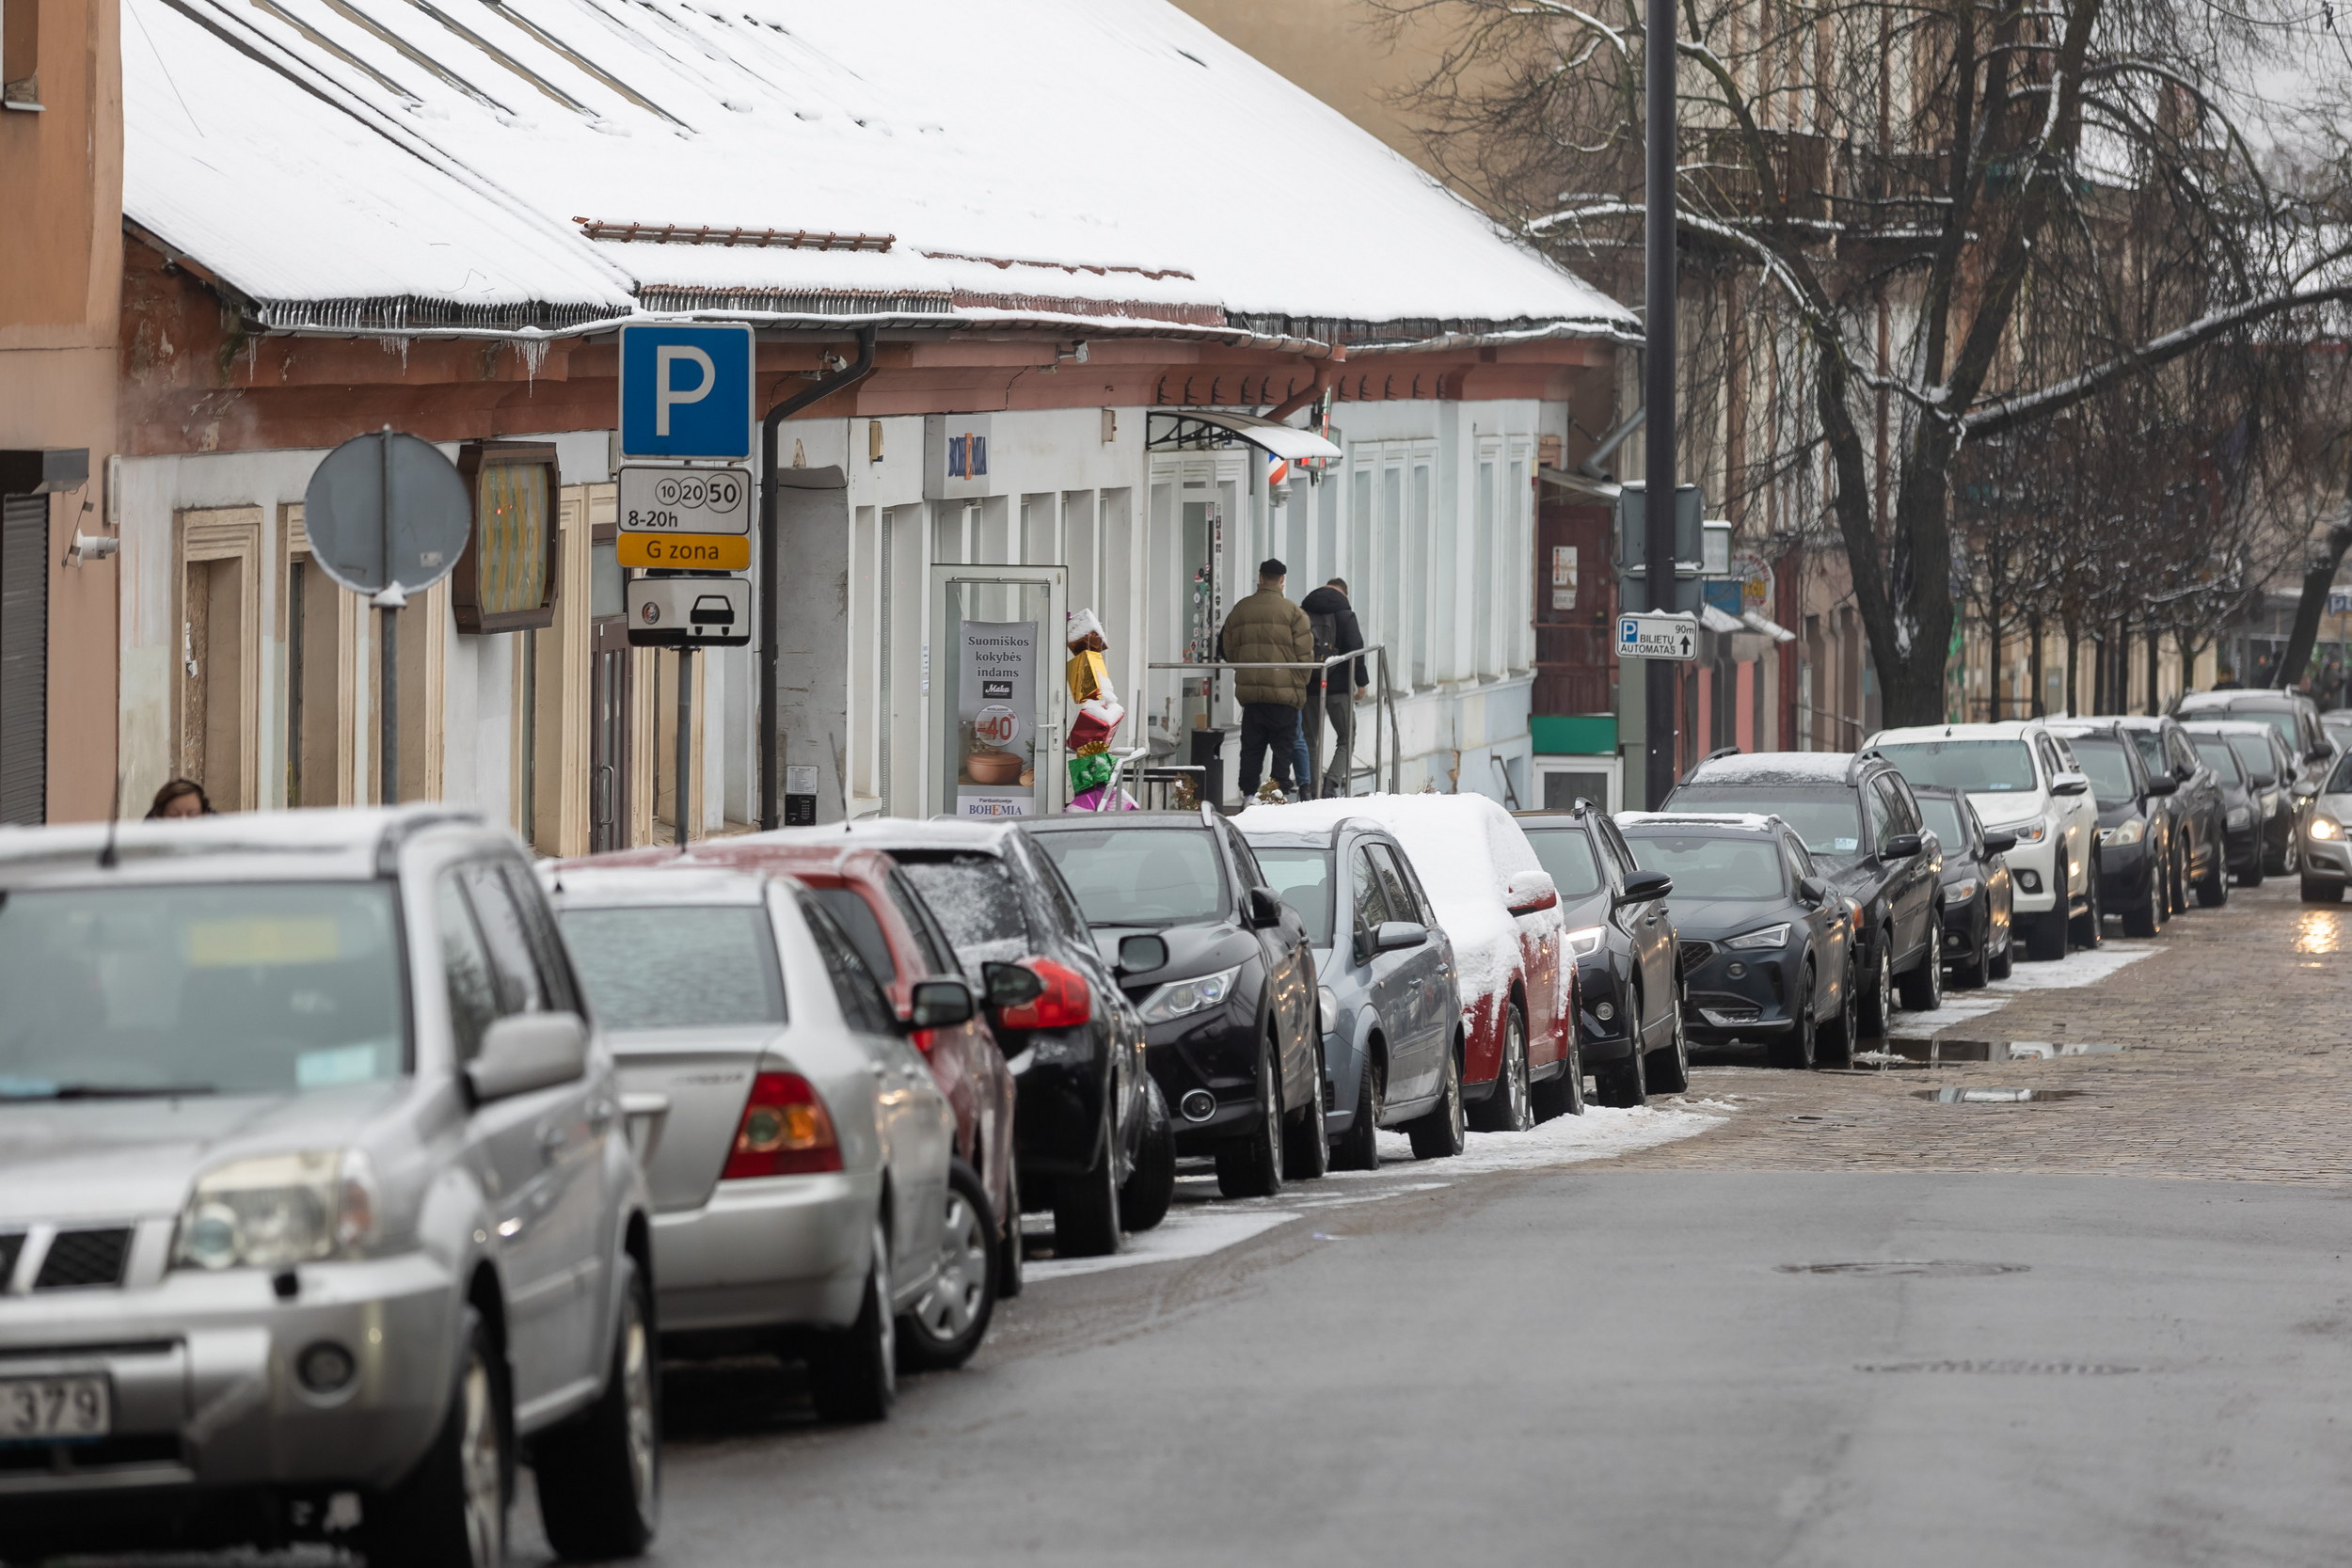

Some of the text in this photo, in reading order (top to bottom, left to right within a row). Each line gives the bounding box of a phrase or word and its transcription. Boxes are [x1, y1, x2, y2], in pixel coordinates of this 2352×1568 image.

[656, 345, 716, 436] P
[661, 483, 737, 503] 10 20 50
[628, 510, 677, 527] 8-20h
[646, 540, 719, 560] G zona
[1623, 622, 1694, 641] P 90m
[968, 636, 1030, 647] Suomiškos
[1640, 634, 1674, 645] BILIETŲ
[1620, 643, 1676, 655] AUTOMATAS
[976, 651, 1023, 664] kokybės
[977, 666, 1020, 678] indams
[969, 804, 1023, 816] BOHEMIA
[13, 1381, 101, 1433] 379
